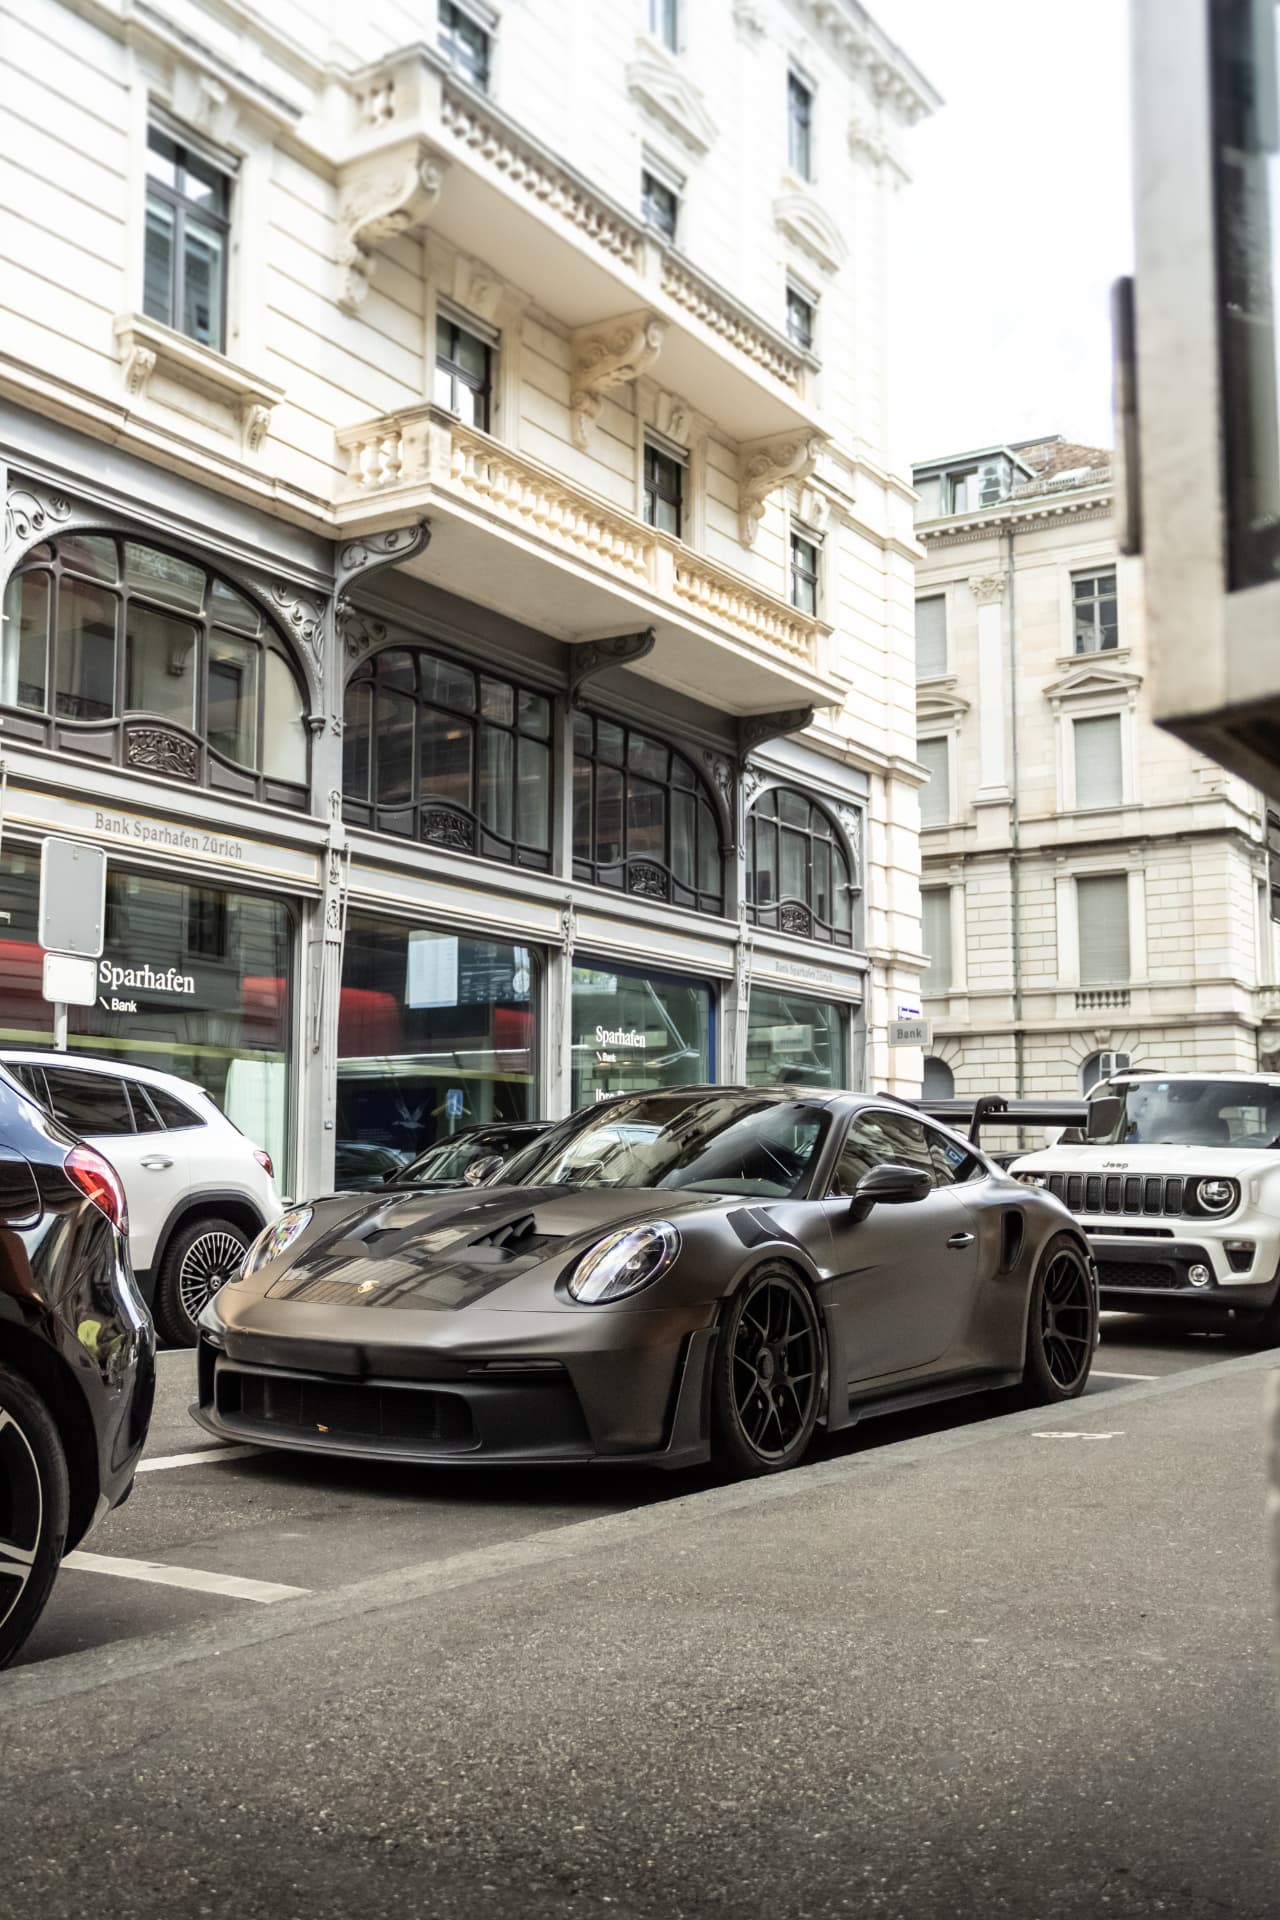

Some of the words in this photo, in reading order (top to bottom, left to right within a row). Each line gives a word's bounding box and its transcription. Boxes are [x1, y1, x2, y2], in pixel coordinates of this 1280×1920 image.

[95, 812, 130, 835] Bank
[134, 821, 199, 849] Sparhafen
[202, 836, 243, 859] Zürich
[99, 960, 195, 994] Sparhafen
[111, 998, 138, 1013] Bank
[596, 1025, 646, 1048] Sparhafen
[897, 1028, 922, 1040] Bank
[1102, 1161, 1129, 1170] Jeep
